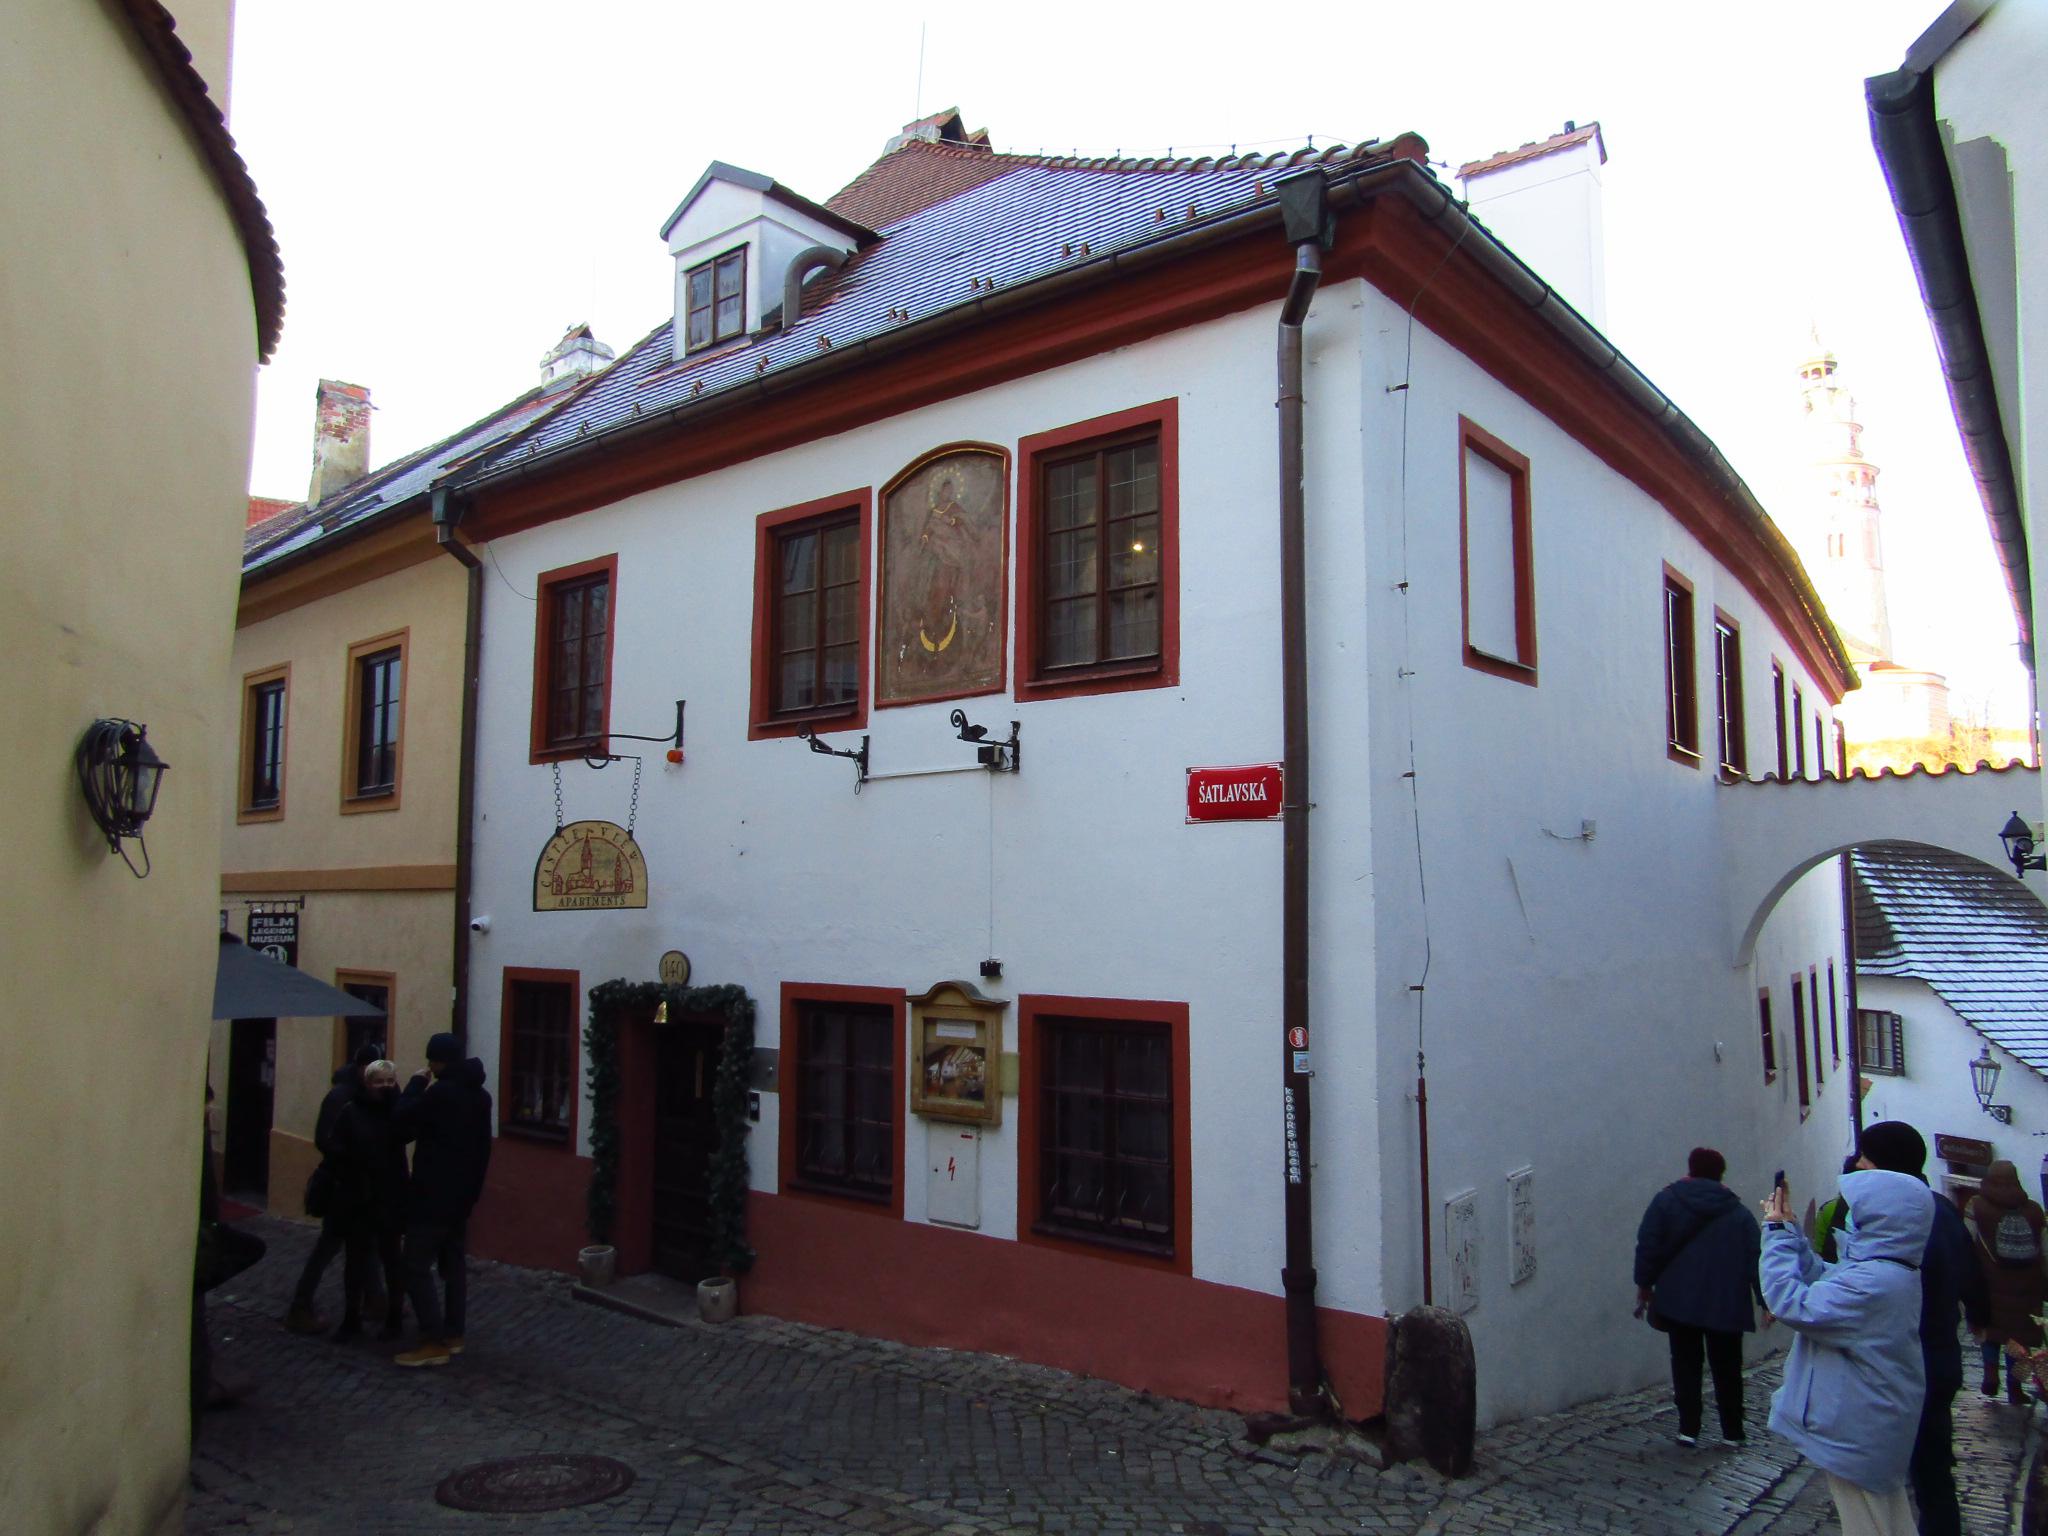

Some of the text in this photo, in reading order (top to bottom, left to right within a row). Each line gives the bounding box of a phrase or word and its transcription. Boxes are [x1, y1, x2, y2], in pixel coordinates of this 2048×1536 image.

[1199, 777, 1267, 803] ŠATLAVSKÁ
[541, 828, 581, 887] CASTLE
[558, 895, 626, 907] APARTMENTS
[252, 917, 294, 927] FILM
[250, 935, 296, 943] MUSEUM
